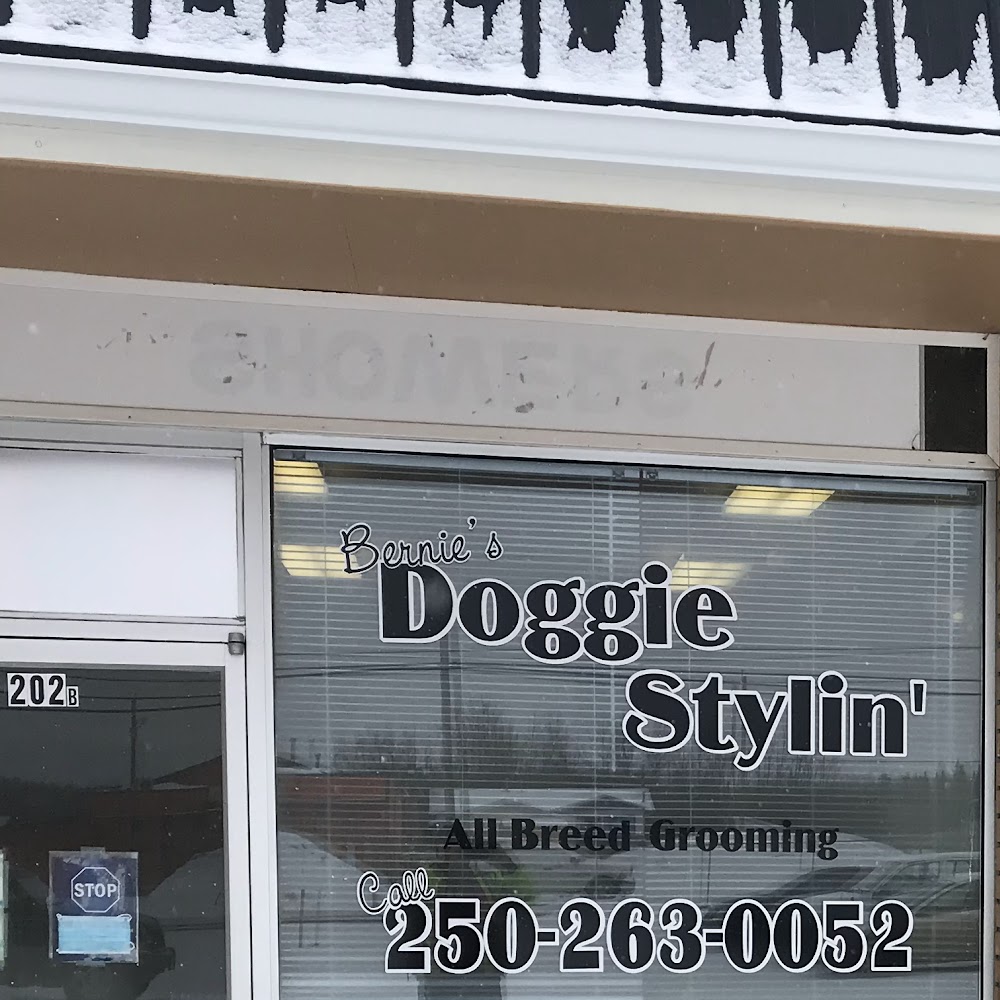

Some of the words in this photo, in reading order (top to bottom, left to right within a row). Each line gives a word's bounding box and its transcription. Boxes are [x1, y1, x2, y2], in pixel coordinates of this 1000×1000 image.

[340, 516, 503, 574] Bernie's
[378, 561, 738, 665] Doggie
[622, 669, 927, 771] Stylin'
[443, 818, 497, 850] All
[511, 818, 631, 851] Breed
[650, 819, 840, 861] Grooming
[73, 882, 118, 898] STOP
[357, 867, 435, 914] Call
[383, 897, 914, 974] 250-263-0052
